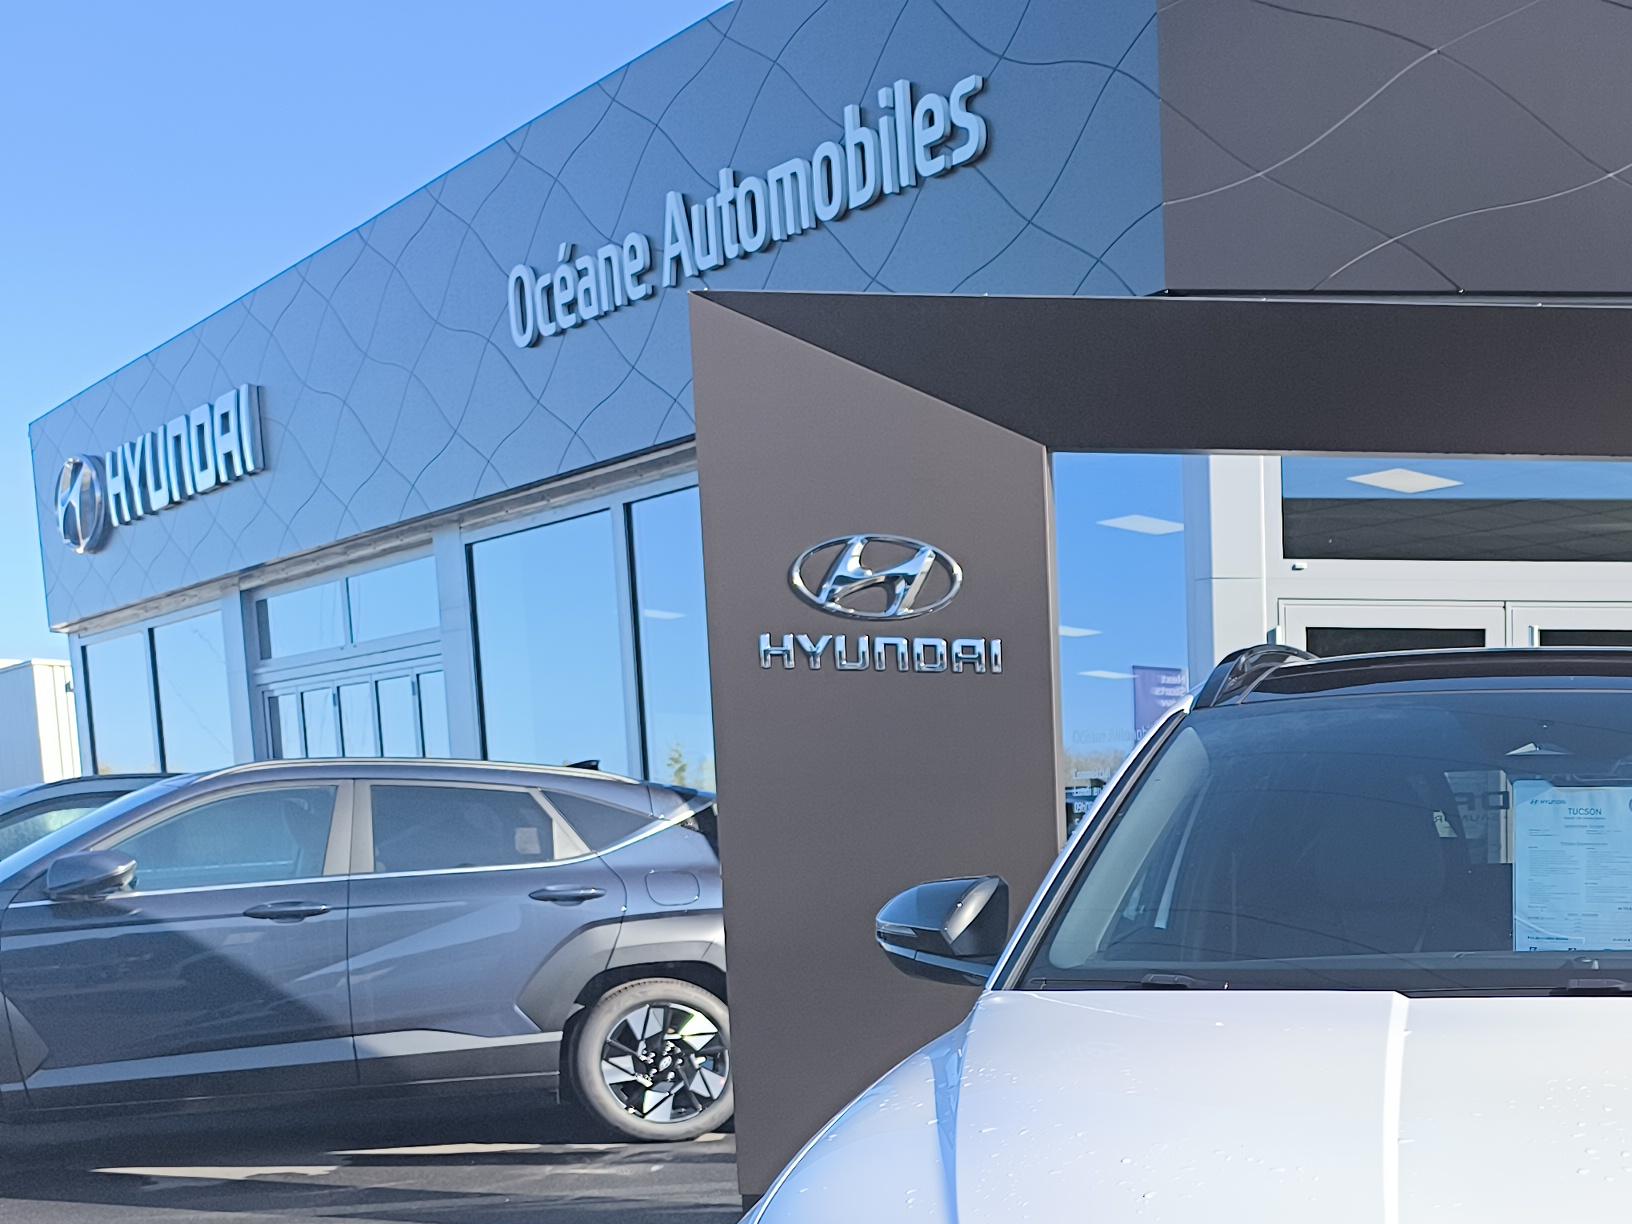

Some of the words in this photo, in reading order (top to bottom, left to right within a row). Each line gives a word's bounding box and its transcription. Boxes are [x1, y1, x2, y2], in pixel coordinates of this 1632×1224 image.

[507, 231, 653, 348] Océane
[661, 75, 988, 287] Automobiles
[105, 383, 263, 528] HYUNDAI
[759, 632, 1002, 674] HYUNDAI
[1568, 807, 1602, 816] TUCSON
